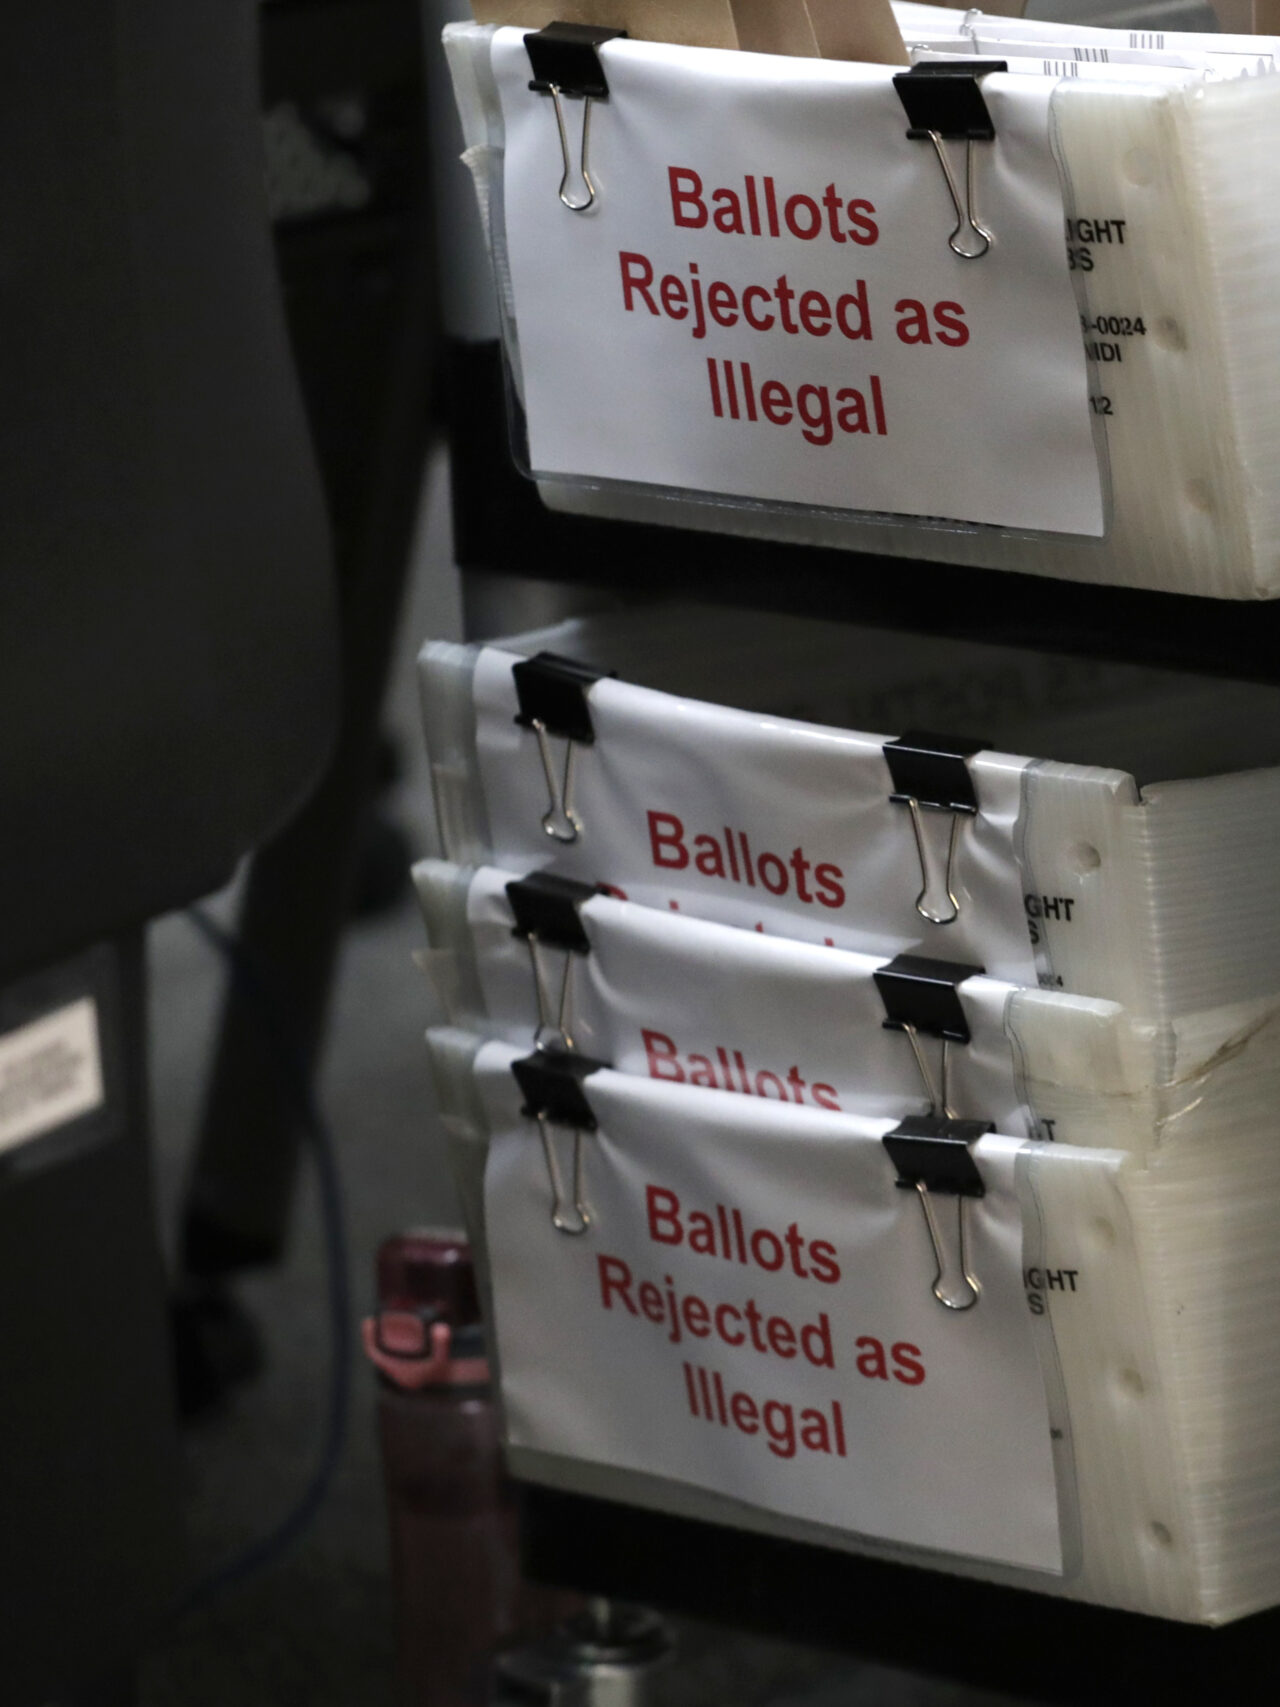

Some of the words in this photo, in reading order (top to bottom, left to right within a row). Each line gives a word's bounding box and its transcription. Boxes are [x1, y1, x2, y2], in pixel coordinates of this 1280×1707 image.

[668, 166, 880, 246] Ballots
[619, 251, 873, 341] Rejected
[895, 299, 970, 347] as
[707, 357, 887, 446] Illegal
[648, 811, 846, 908] Ballots
[641, 1028, 843, 1112] Ballots
[646, 1185, 841, 1284] Ballots
[598, 1254, 834, 1369] Rejected
[855, 1336, 926, 1386] as
[683, 1362, 847, 1458] Illegal
